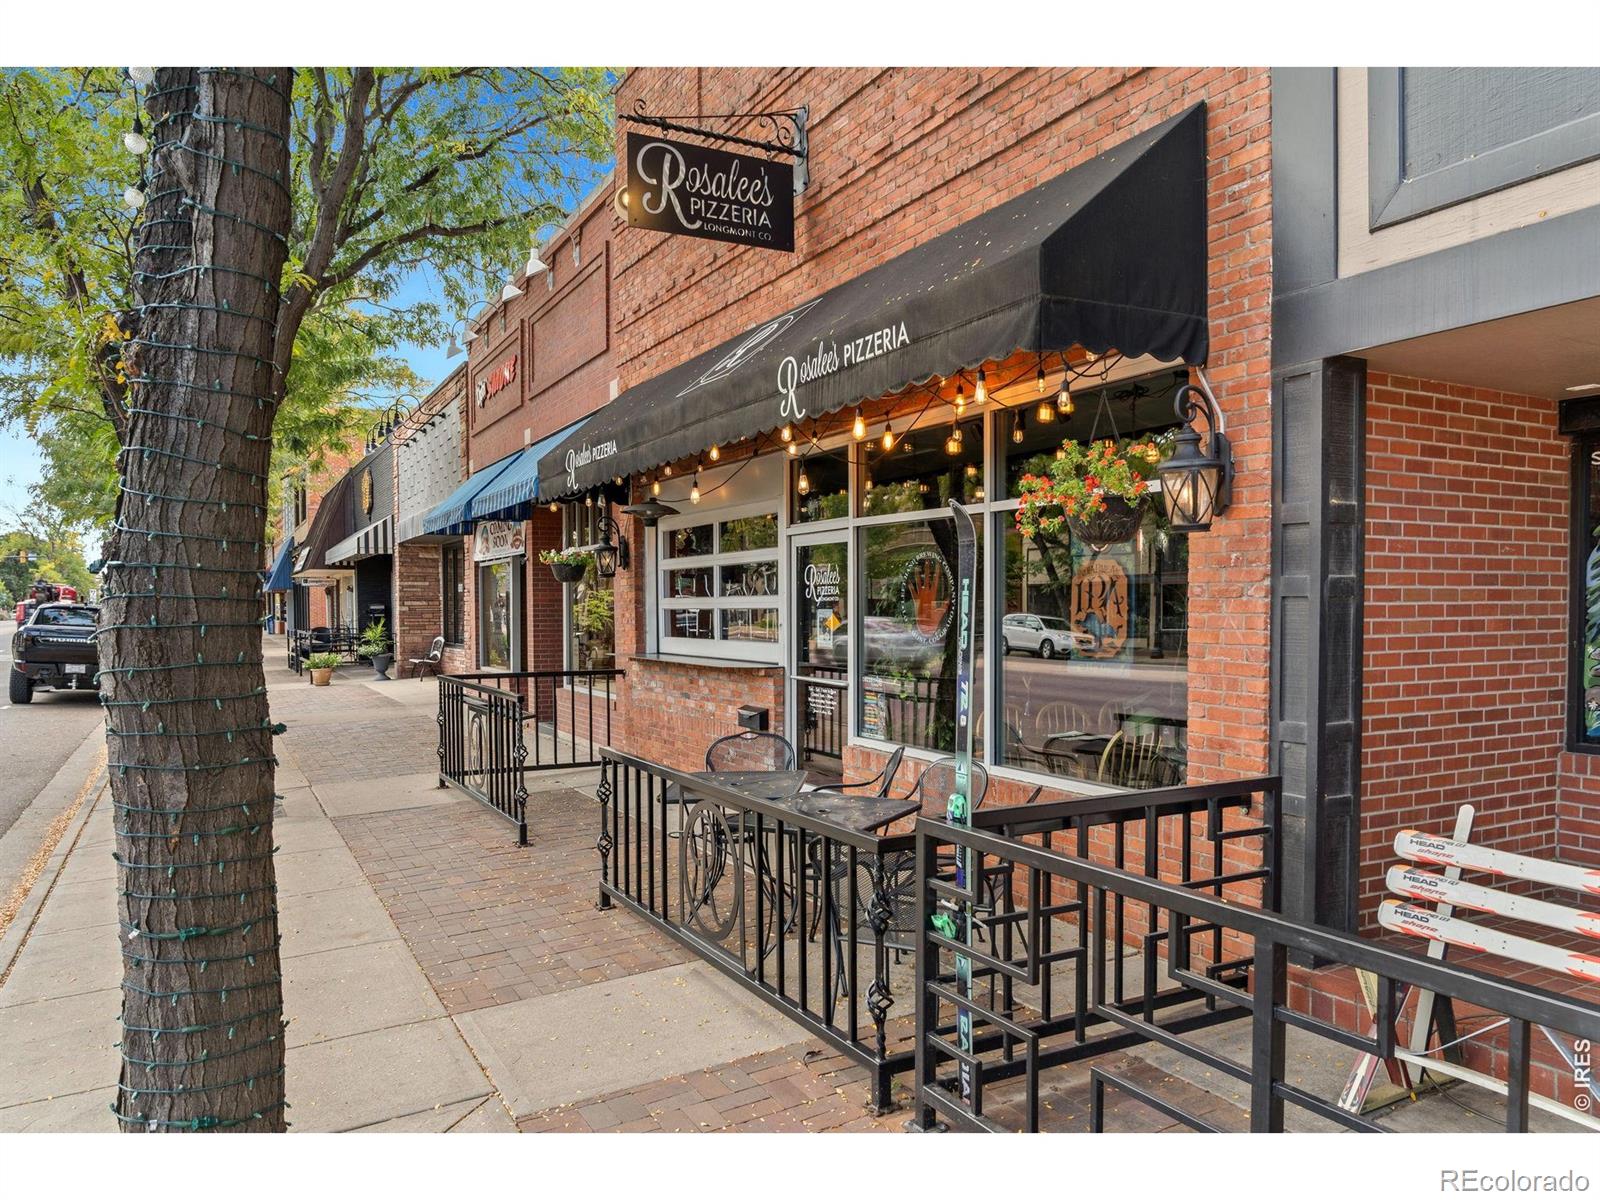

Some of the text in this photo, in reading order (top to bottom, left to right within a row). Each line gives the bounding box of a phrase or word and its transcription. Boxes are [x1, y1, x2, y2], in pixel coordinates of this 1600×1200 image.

[636, 142, 775, 230] Rosalee's
[690, 197, 773, 229] PIZZERIA
[703, 222, 757, 239] LONGMONT
[777, 321, 911, 419] Rosalee's PIZZERIA
[592, 440, 618, 461] PIZZERIA
[961, 578, 969, 649] HEAD
[1409, 839, 1446, 850] HEAD
[1403, 874, 1439, 887] HEAD
[1394, 909, 1430, 923] HEAD
